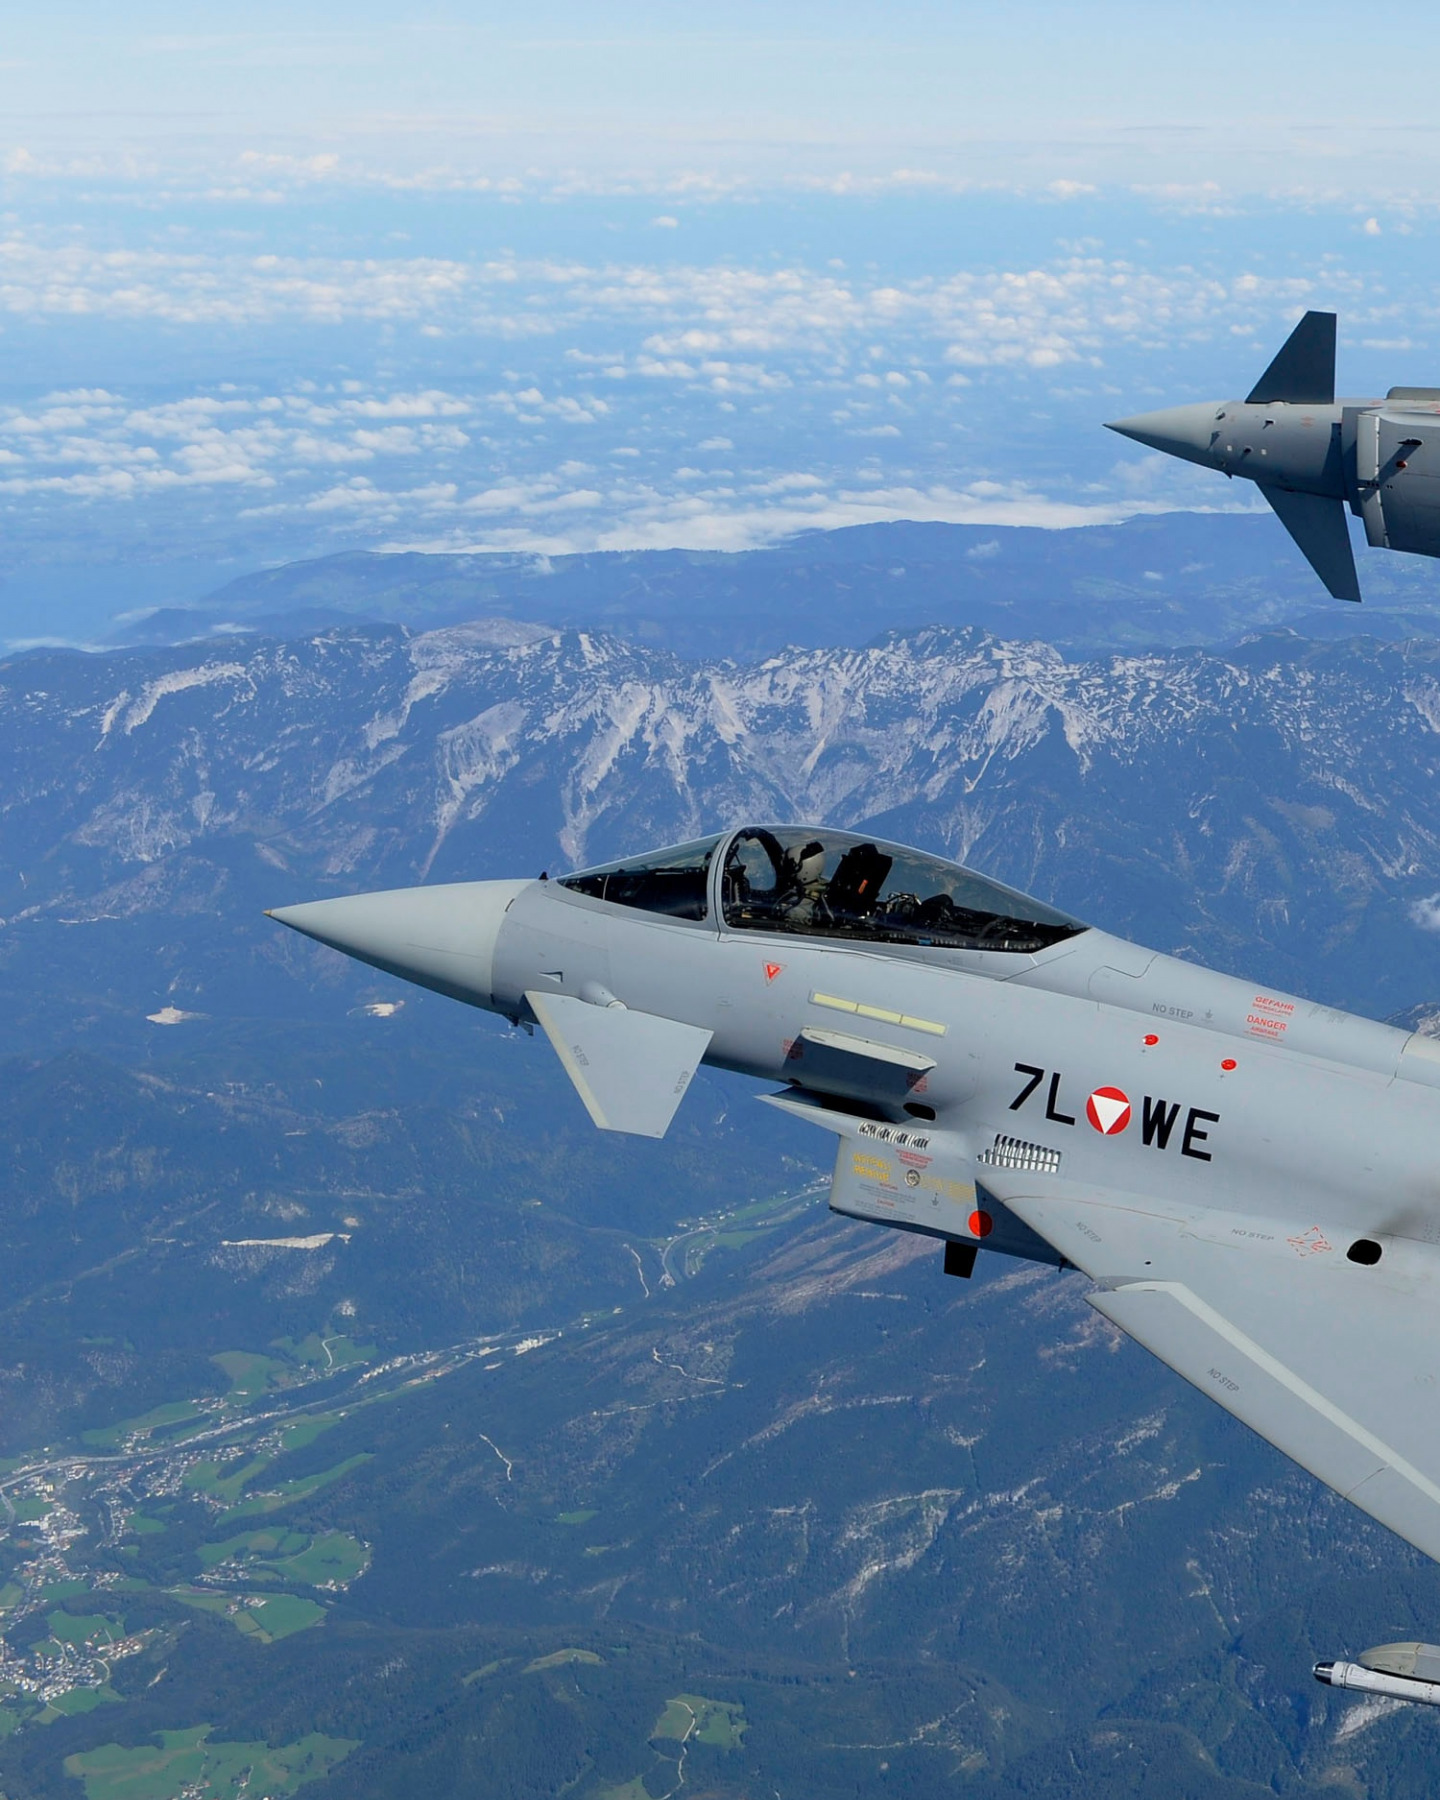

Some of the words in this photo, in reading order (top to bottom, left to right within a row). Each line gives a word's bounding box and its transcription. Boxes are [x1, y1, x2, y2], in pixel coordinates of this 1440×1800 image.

[1152, 1002, 1167, 1014] NO
[1170, 1006, 1194, 1019] STEP
[1255, 995, 1294, 1011] GEFAHR
[1246, 1014, 1287, 1031] DANGER
[1008, 1062, 1075, 1126] 7L
[1142, 1095, 1220, 1162] WE
[1231, 1228, 1247, 1236] NO
[1248, 1231, 1274, 1241] STEP
[1207, 1368, 1221, 1379] NO
[1219, 1377, 1239, 1391] STEP
